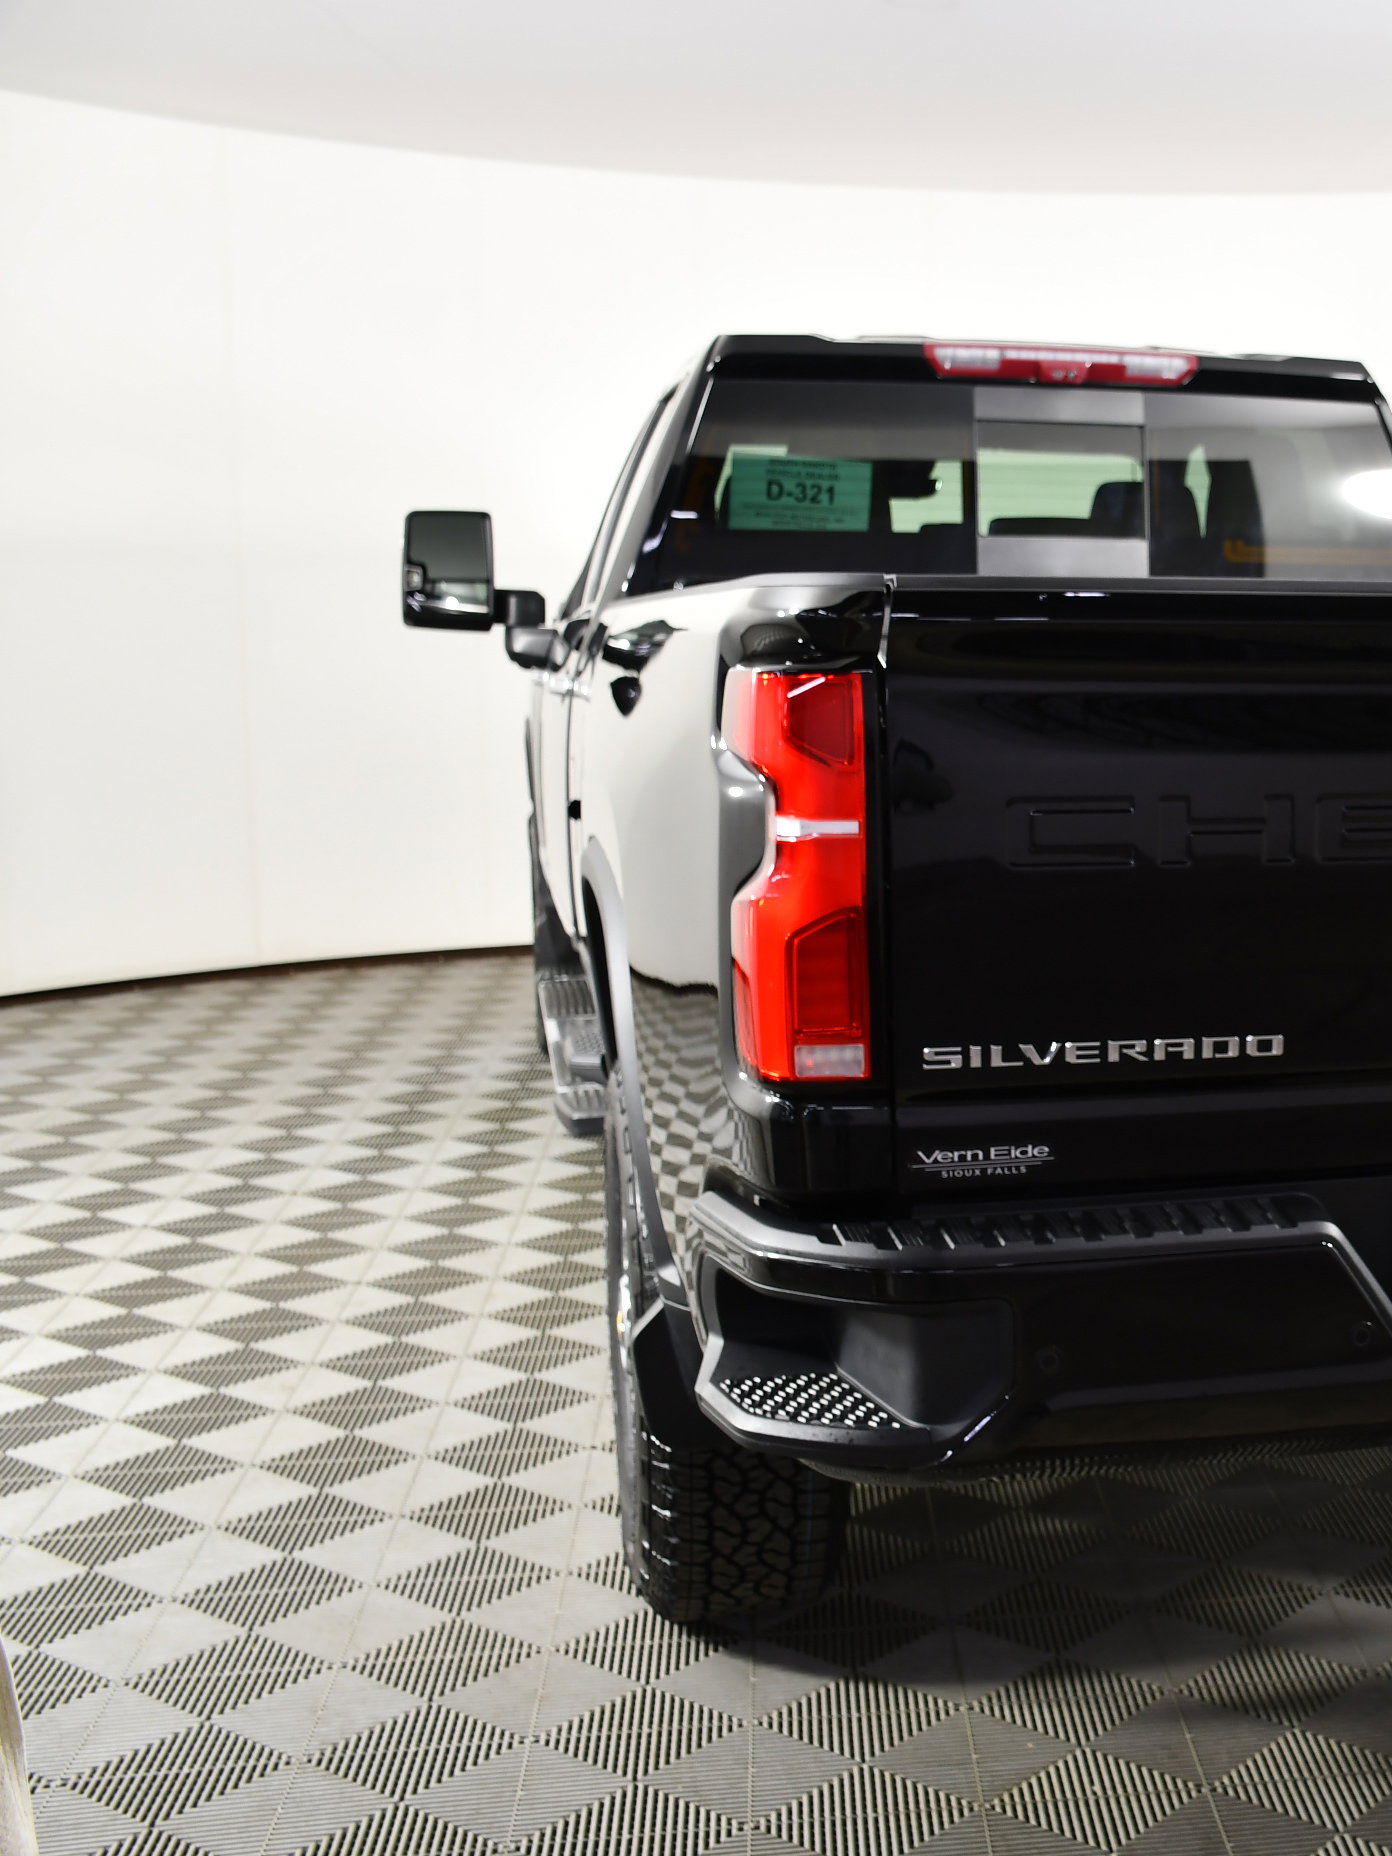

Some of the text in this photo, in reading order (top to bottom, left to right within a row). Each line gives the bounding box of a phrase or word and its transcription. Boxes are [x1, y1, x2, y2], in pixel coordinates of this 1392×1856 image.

[766, 479, 835, 505] D-321
[922, 1034, 1284, 1070] SILVERADO
[916, 1143, 1050, 1165] Vern Eide
[941, 1166, 1027, 1178] SIOUX FALLS
